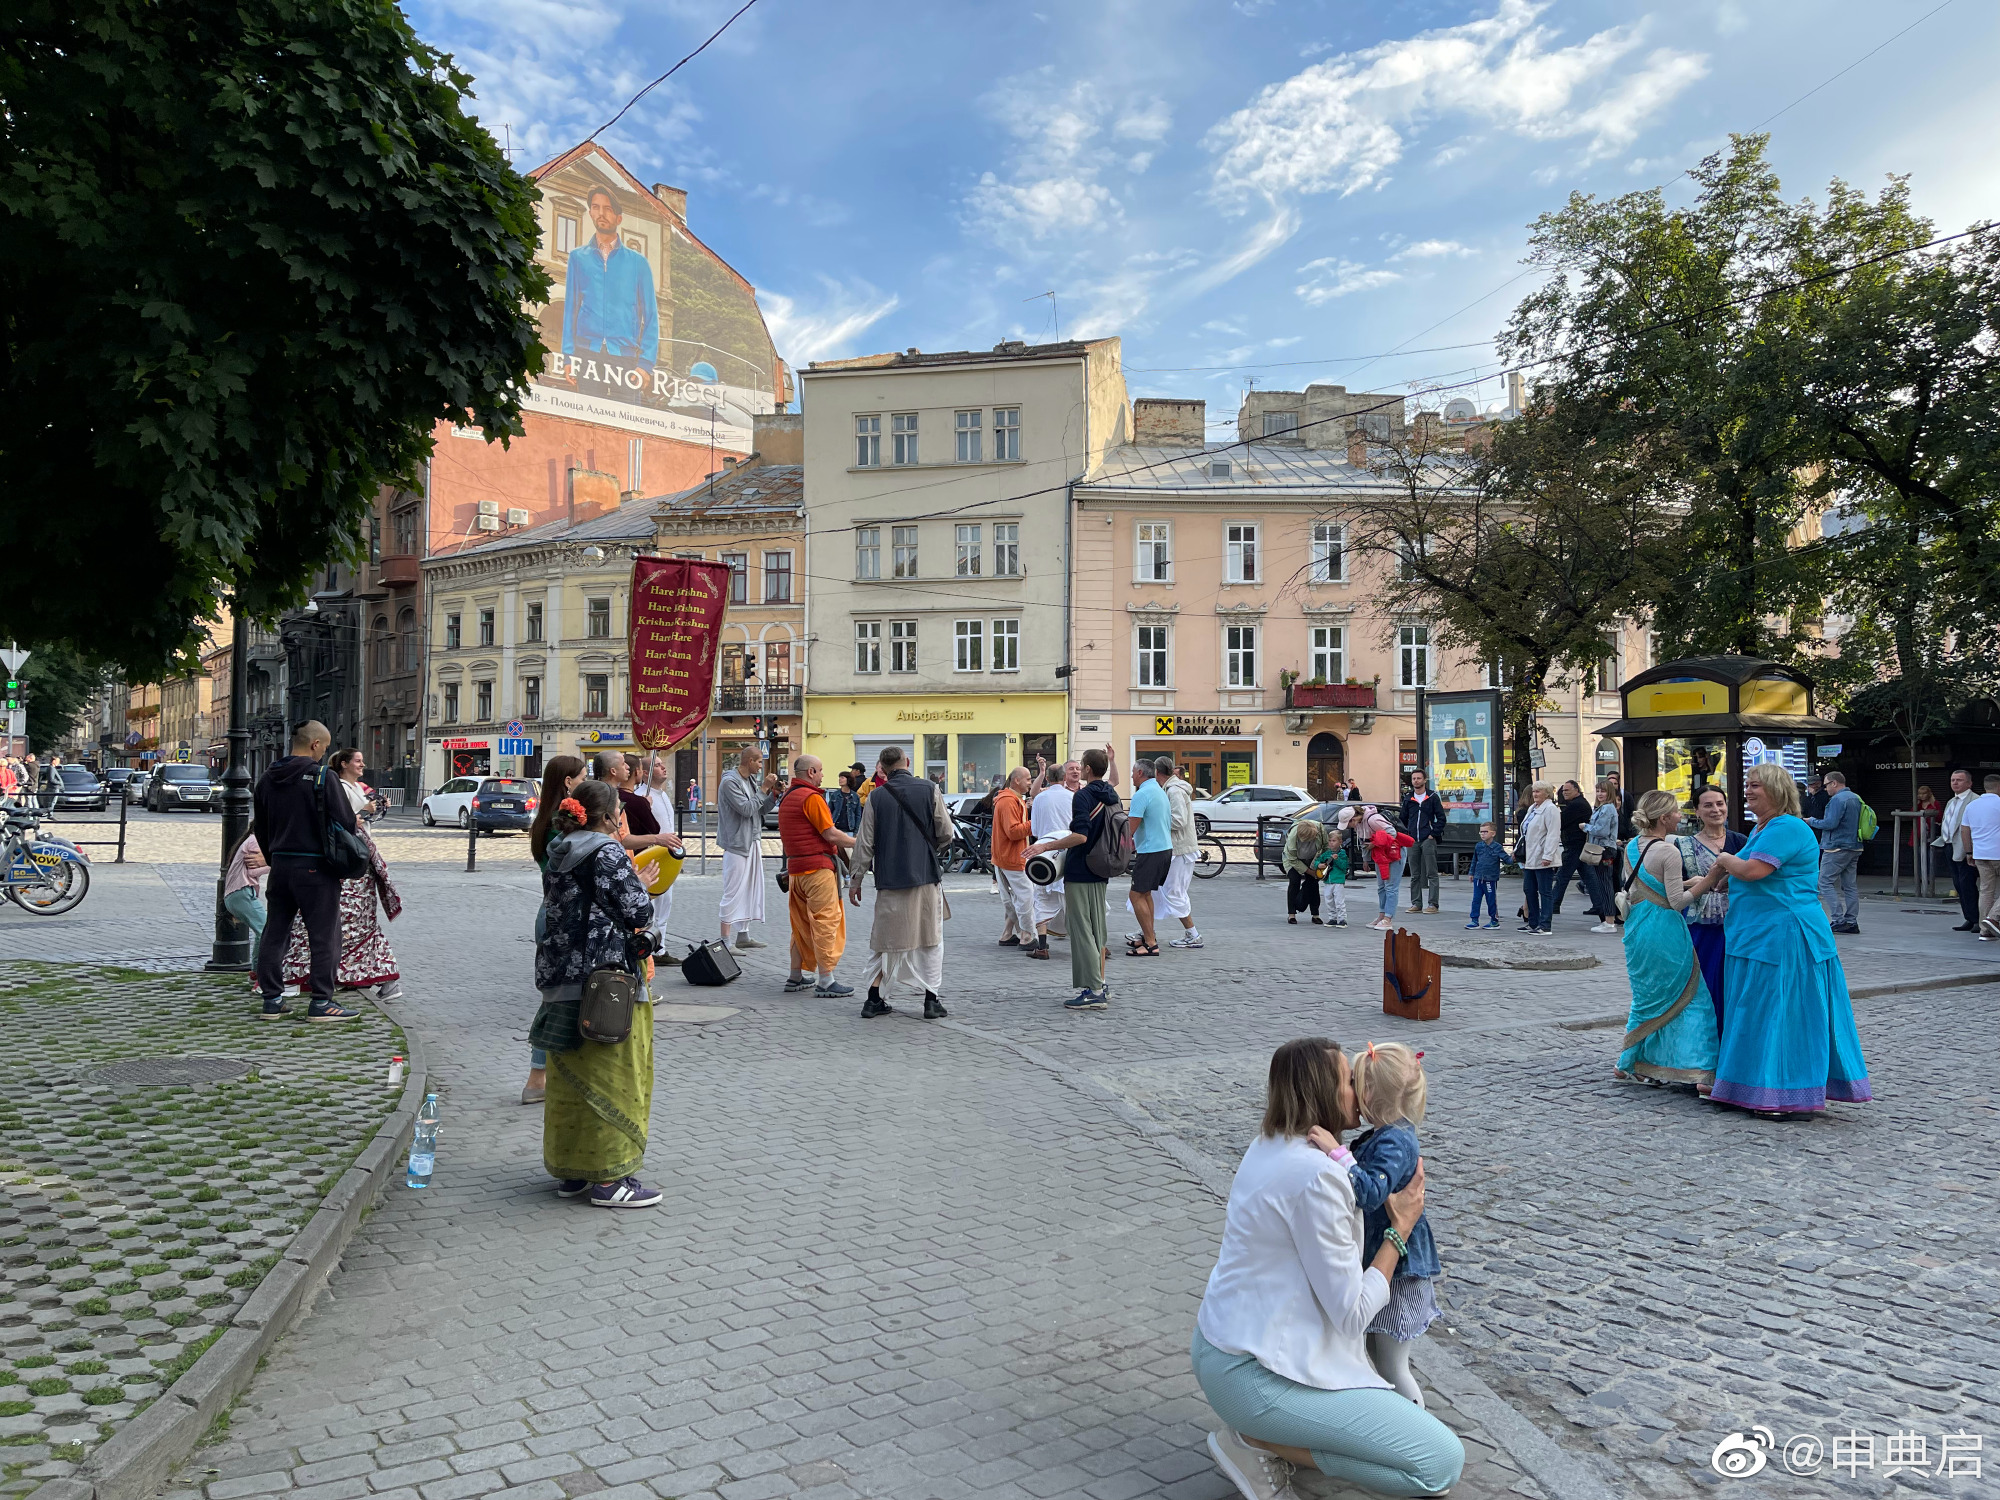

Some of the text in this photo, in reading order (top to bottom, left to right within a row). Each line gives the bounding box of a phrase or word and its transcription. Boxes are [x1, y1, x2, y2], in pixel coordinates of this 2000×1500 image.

[551, 352, 643, 390] EFANO
[550, 396, 584, 412] Площа
[586, 406, 616, 418] Адама
[670, 421, 676, 430] 8
[650, 586, 674, 596] Hare
[648, 602, 672, 612] Hare
[671, 631, 693, 642] Hare
[663, 666, 689, 678] Rama
[661, 683, 689, 697] Rama
[659, 700, 683, 713] Hare
[1176, 716, 1241, 724] Raiffeisen
[1176, 725, 1241, 735] BANK AVAL
[1904, 761, 1930, 769] DRNKS
